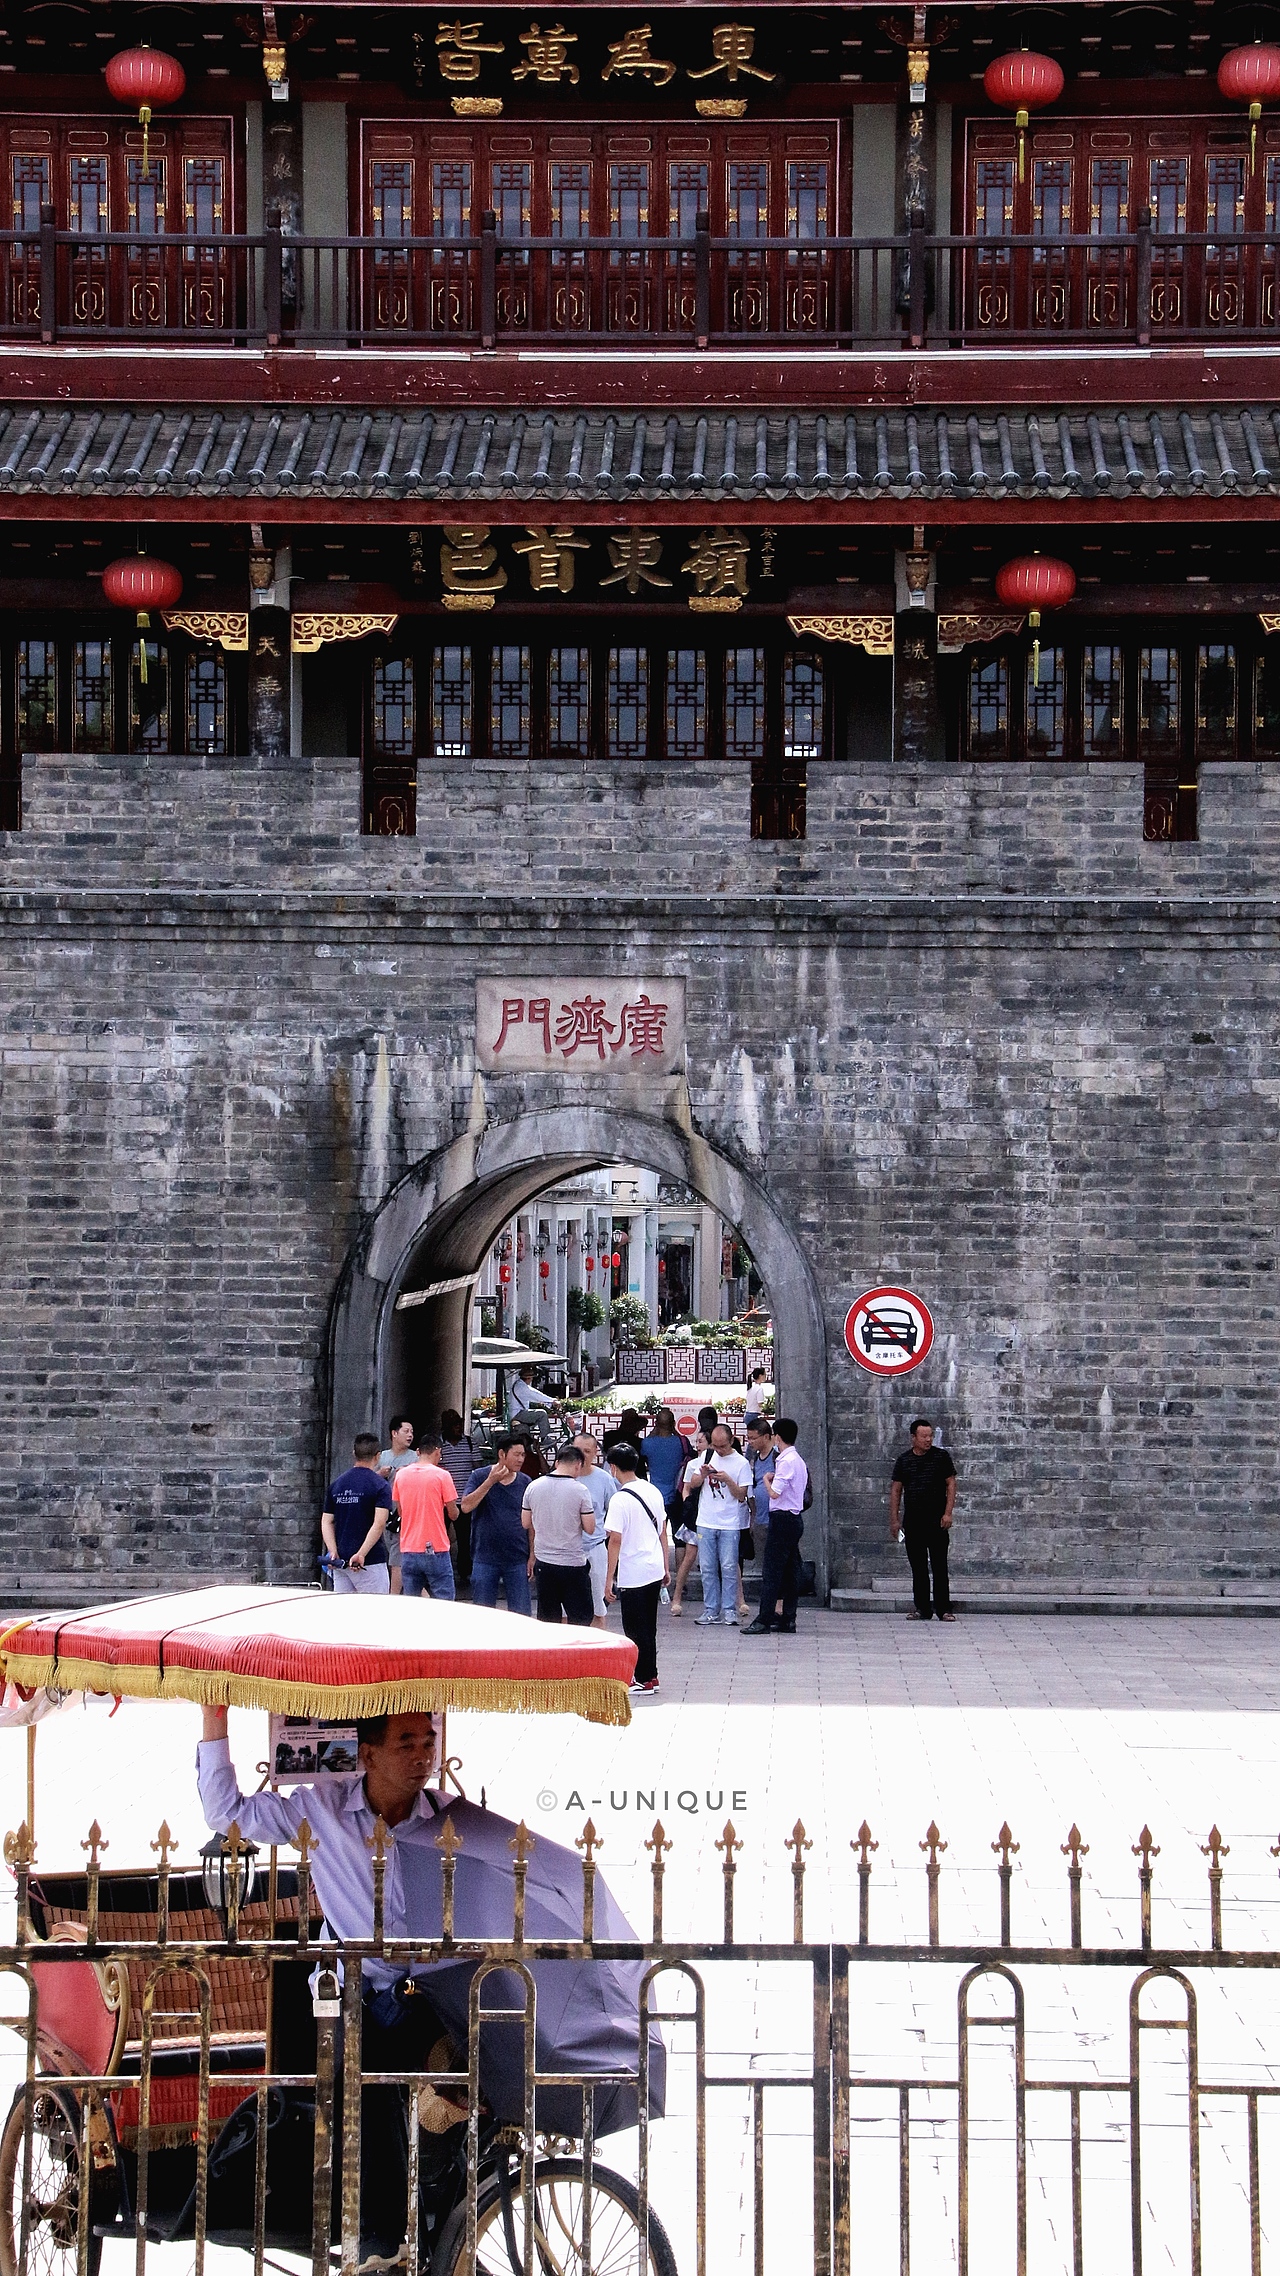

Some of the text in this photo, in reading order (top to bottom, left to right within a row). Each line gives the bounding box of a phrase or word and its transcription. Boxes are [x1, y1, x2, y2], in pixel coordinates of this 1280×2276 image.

[492, 994, 669, 1060] 廣濟門
[875, 1351, 904, 1359] 含摩托车
